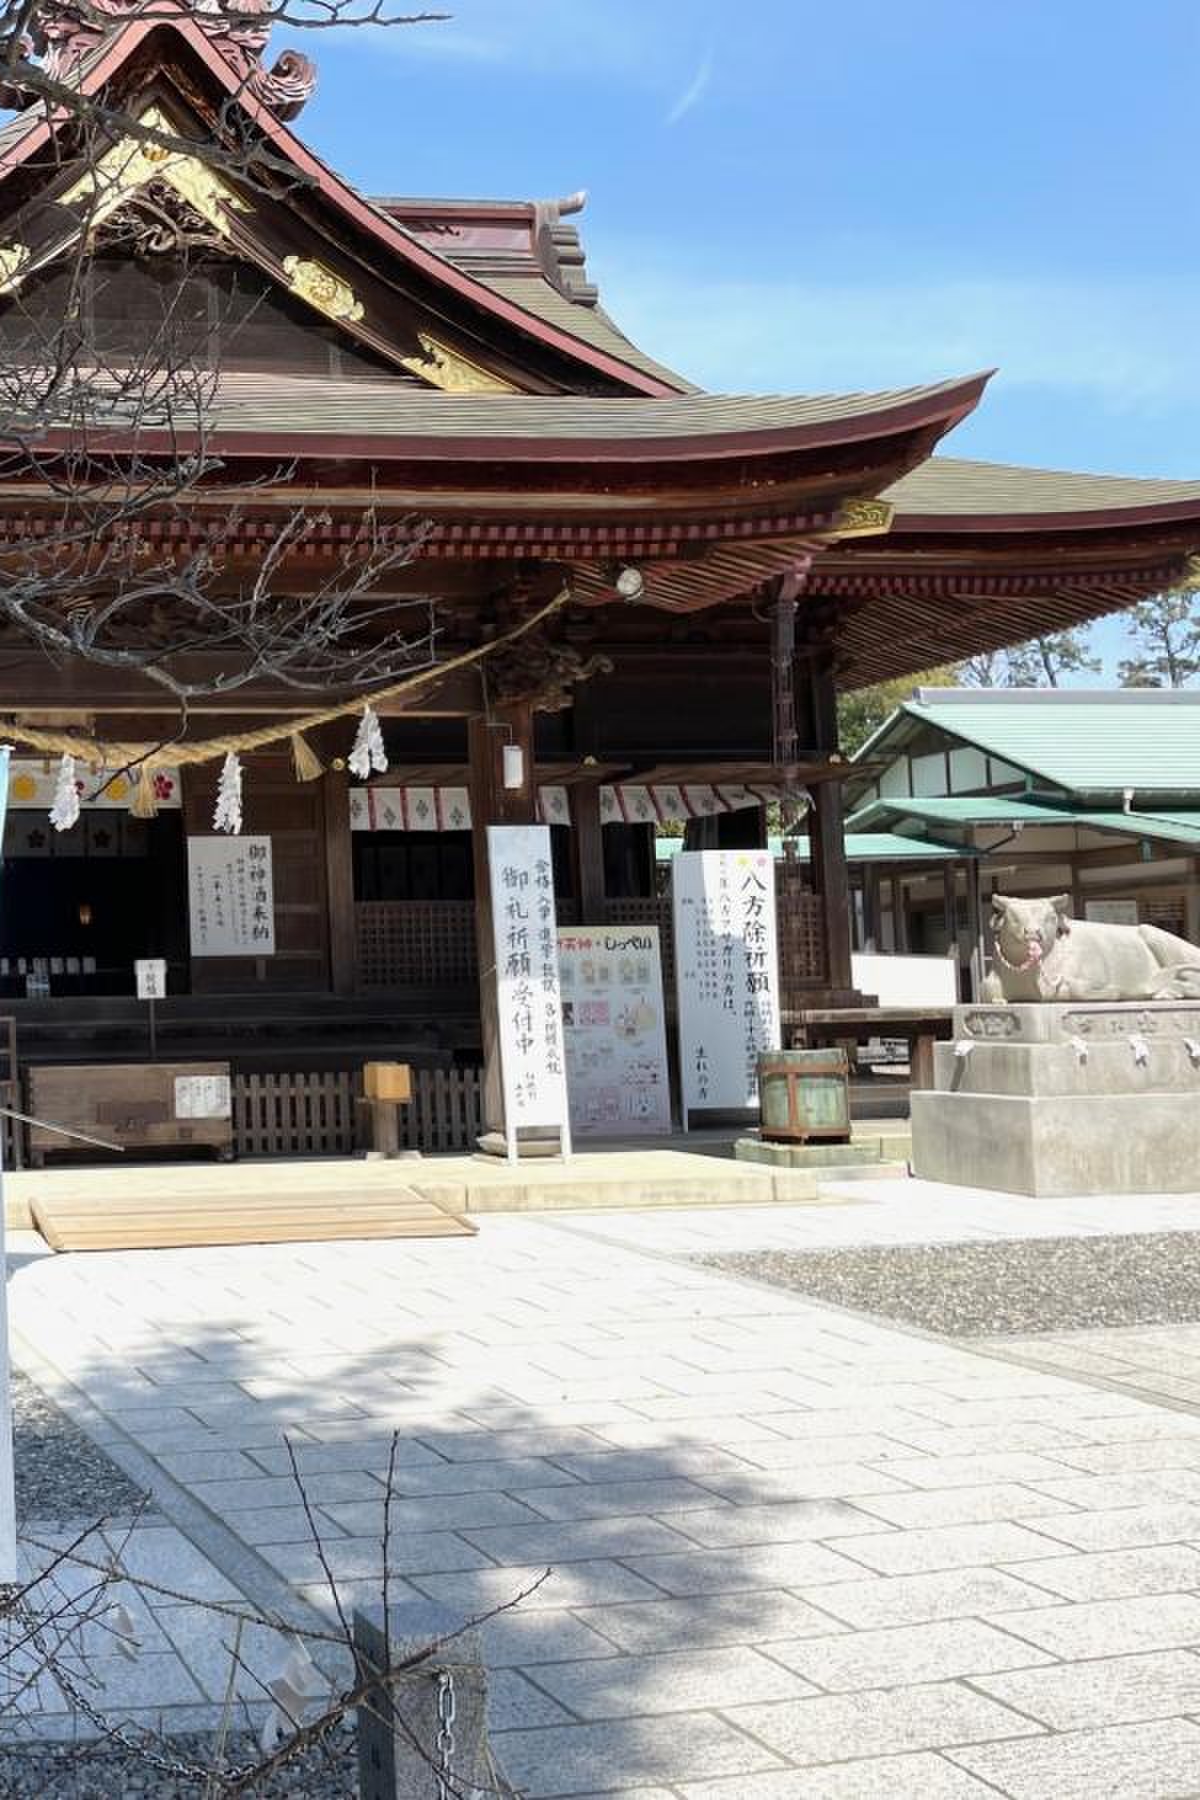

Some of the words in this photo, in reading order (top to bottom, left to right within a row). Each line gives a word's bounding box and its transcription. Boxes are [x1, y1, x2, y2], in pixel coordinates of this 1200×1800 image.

[740, 870, 770, 994] 八方除祈願
